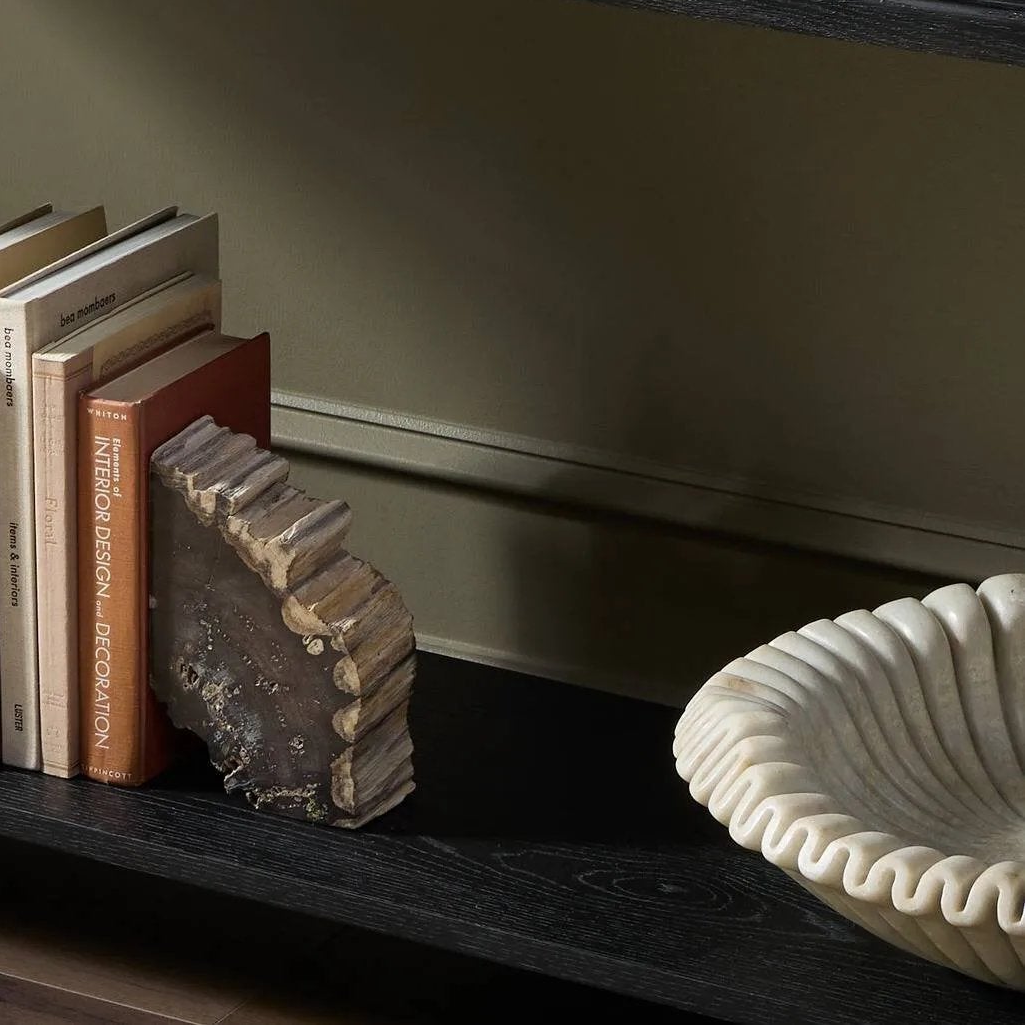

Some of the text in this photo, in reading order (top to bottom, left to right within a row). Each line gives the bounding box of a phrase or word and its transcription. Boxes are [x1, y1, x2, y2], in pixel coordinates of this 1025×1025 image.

[60, 293, 116, 327] bea mombaers
[4, 327, 16, 407] bea mombaers
[87, 408, 127, 421] WHITON
[112, 437, 122, 498] Elements of
[9, 522, 19, 549] items
[45, 497, 58, 545] Floral
[10, 564, 21, 607] interiors
[94, 435, 111, 750] INTERIOR DESIGN and DECORATION
[14, 703, 23, 732] LUSTER
